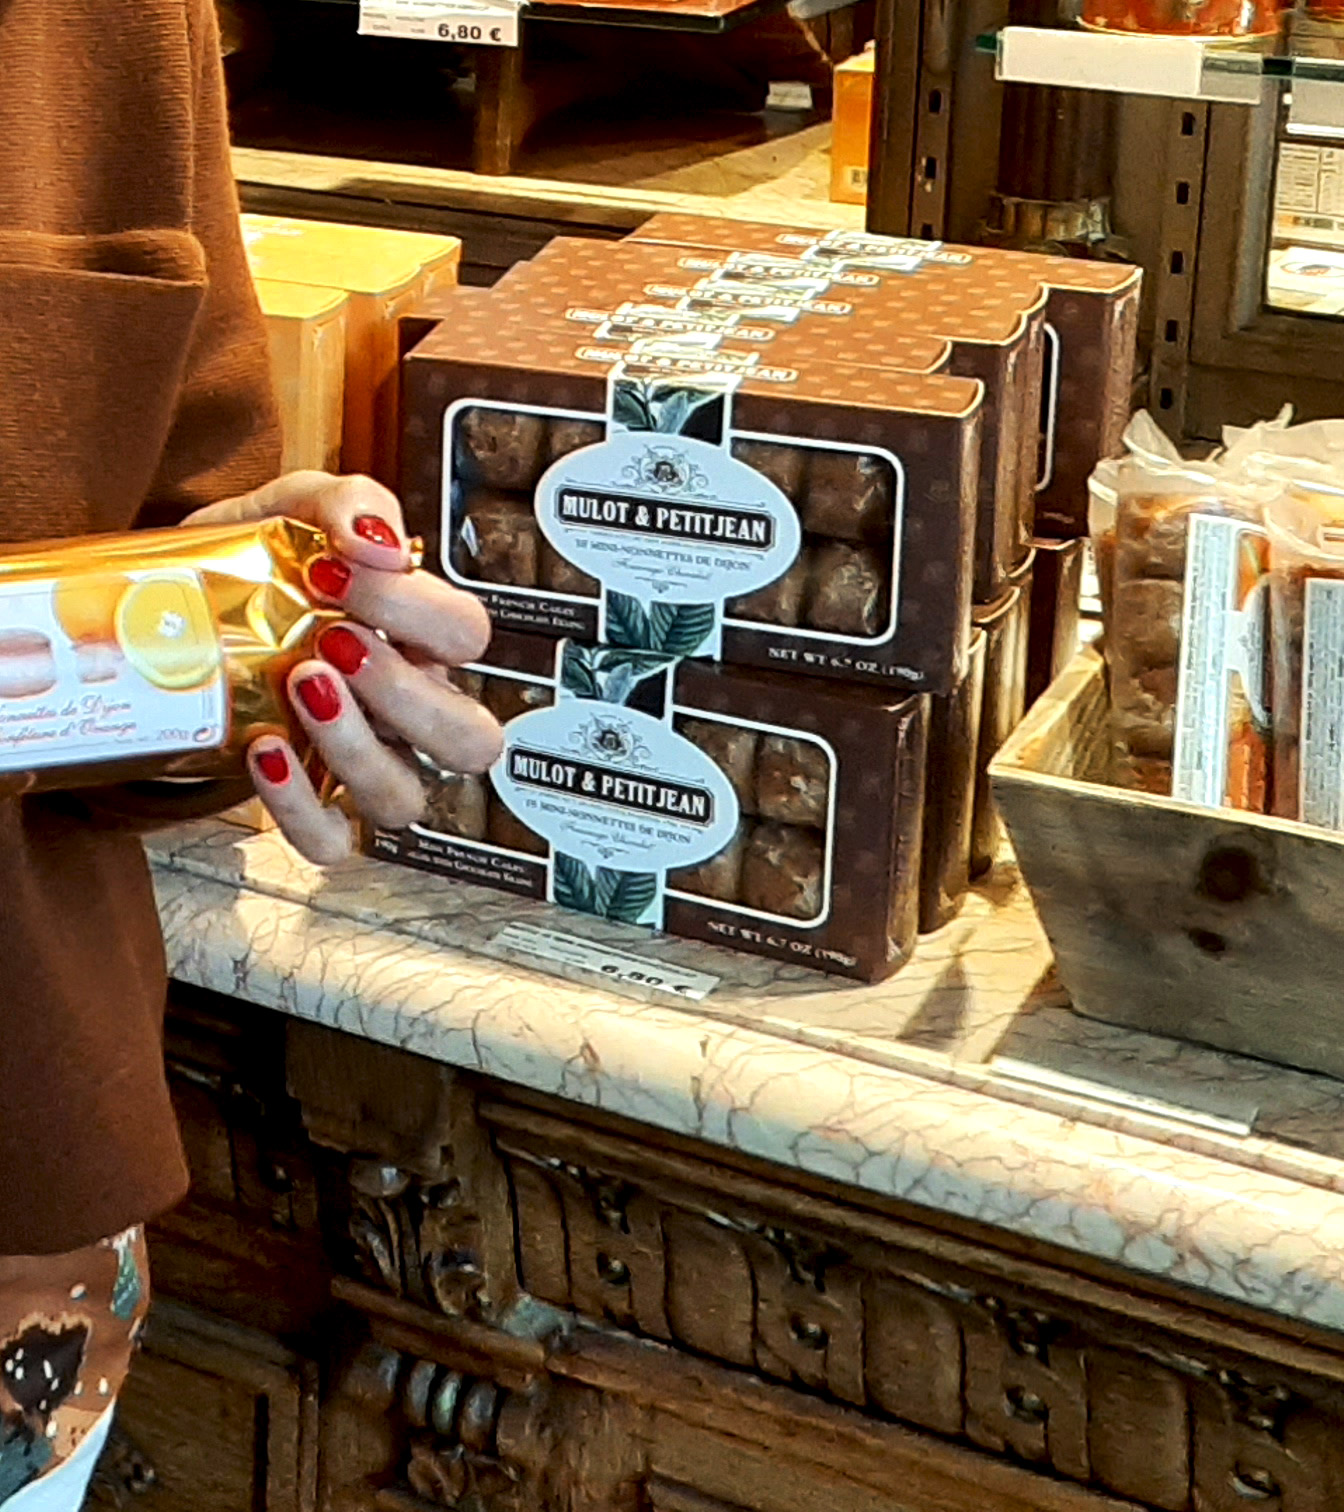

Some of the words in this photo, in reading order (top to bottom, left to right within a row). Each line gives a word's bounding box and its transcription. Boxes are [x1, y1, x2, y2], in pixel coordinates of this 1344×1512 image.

[437, 23, 481, 40] 6,80
[490, 27, 501, 42] €
[661, 319, 770, 339] PETITJEAN
[678, 359, 790, 380] PETITJEAN
[563, 495, 629, 523] MULOT
[635, 505, 650, 526] &
[657, 507, 766, 541] PETITJEAN
[696, 556, 710, 565] DE
[715, 559, 751, 570] DIJON
[768, 648, 797, 660] NET
[804, 652, 827, 665] WT
[855, 661, 880, 673] OZ
[61, 702, 77, 717] de
[81, 694, 131, 719] Dijon
[514, 755, 576, 787] MULOT
[581, 771, 596, 791] &
[602, 775, 705, 817] PETITJEAN
[639, 825, 654, 834] DE
[657, 829, 691, 843] DIJON
[790, 942, 812, 955] OZ
